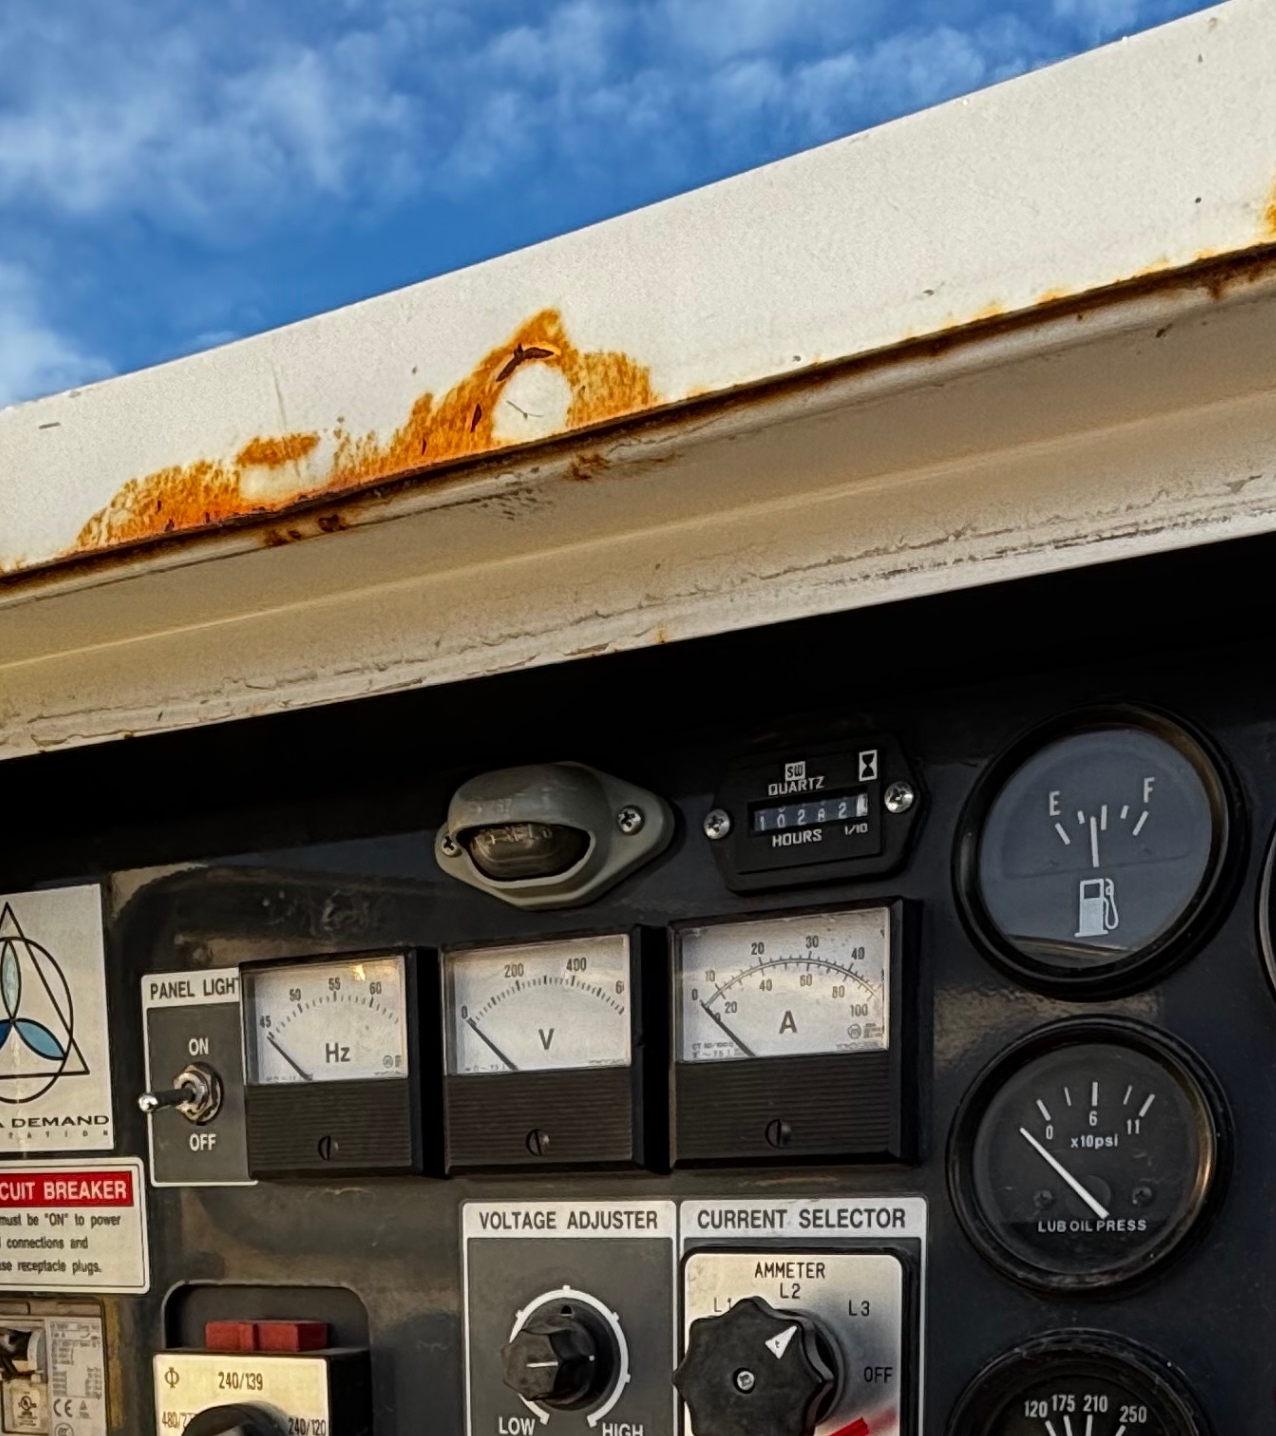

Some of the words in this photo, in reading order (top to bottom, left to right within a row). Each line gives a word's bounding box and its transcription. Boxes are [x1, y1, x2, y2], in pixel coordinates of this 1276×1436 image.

[768, 776, 825, 796] QUARTZ
[1143, 777, 1155, 801] F
[1049, 790, 1061, 816] E
[845, 823, 868, 835] 1/10
[772, 829, 822, 847] HOURS
[752, 942, 764, 955] 20
[806, 936, 818, 948] 30
[851, 947, 865, 960] 40
[504, 963, 523, 978] 200
[567, 957, 586, 972] 400
[705, 970, 715, 982] 10
[800, 974, 812, 986] 60
[150, 981, 195, 999] PANEL
[329, 977, 341, 991] 55
[370, 982, 382, 995] 60
[759, 979, 772, 991] 40
[289, 988, 301, 1001] 50
[692, 989, 697, 1000] 0
[832, 986, 845, 998] 80
[461, 1006, 468, 1019] 0
[725, 1001, 737, 1014] 20
[850, 1004, 868, 1017] 100
[259, 1016, 271, 1029] 45
[779, 1010, 797, 1034] A
[539, 1028, 554, 1050] V
[189, 1038, 208, 1056] ON
[326, 1042, 350, 1063] Hz
[12, 1116, 109, 1128] DEMAND
[1089, 1111, 1097, 1126] 6
[1046, 1126, 1053, 1140] 0
[1127, 1119, 1140, 1134] 11
[190, 1134, 216, 1151] OFF
[1070, 1133, 1118, 1149] x10psi
[44, 1181, 126, 1199] BREAKER
[0, 1214, 22, 1226] must
[27, 1214, 38, 1226] be
[75, 1214, 84, 1225] to
[91, 1215, 121, 1228] power
[479, 1211, 557, 1230] VOLTAGE
[567, 1211, 658, 1229] ADJUSTER
[697, 1210, 787, 1229] CURRENT
[799, 1209, 905, 1229] SELECTOR
[1038, 1220, 1067, 1233] LUB
[1069, 1220, 1093, 1232] OIL
[1097, 1219, 1146, 1232] PRESS
[7, 1237, 64, 1249] connections
[71, 1237, 88, 1248] and
[18, 1261, 66, 1272] receptacle
[72, 1261, 101, 1275] plugs.
[755, 1263, 825, 1278] AMMETER
[780, 1283, 800, 1298] L2
[849, 1300, 870, 1317] L3
[218, 1372, 263, 1391] 240/139
[864, 1368, 893, 1383] OFF
[54, 1399, 73, 1417] CE
[1025, 1401, 1047, 1417] 120
[1052, 1395, 1076, 1412] 175
[1084, 1395, 1108, 1413] 210
[1120, 1406, 1147, 1424] 250
[289, 1418, 326, 1436] 240/120
[499, 1418, 535, 1436] LOW
